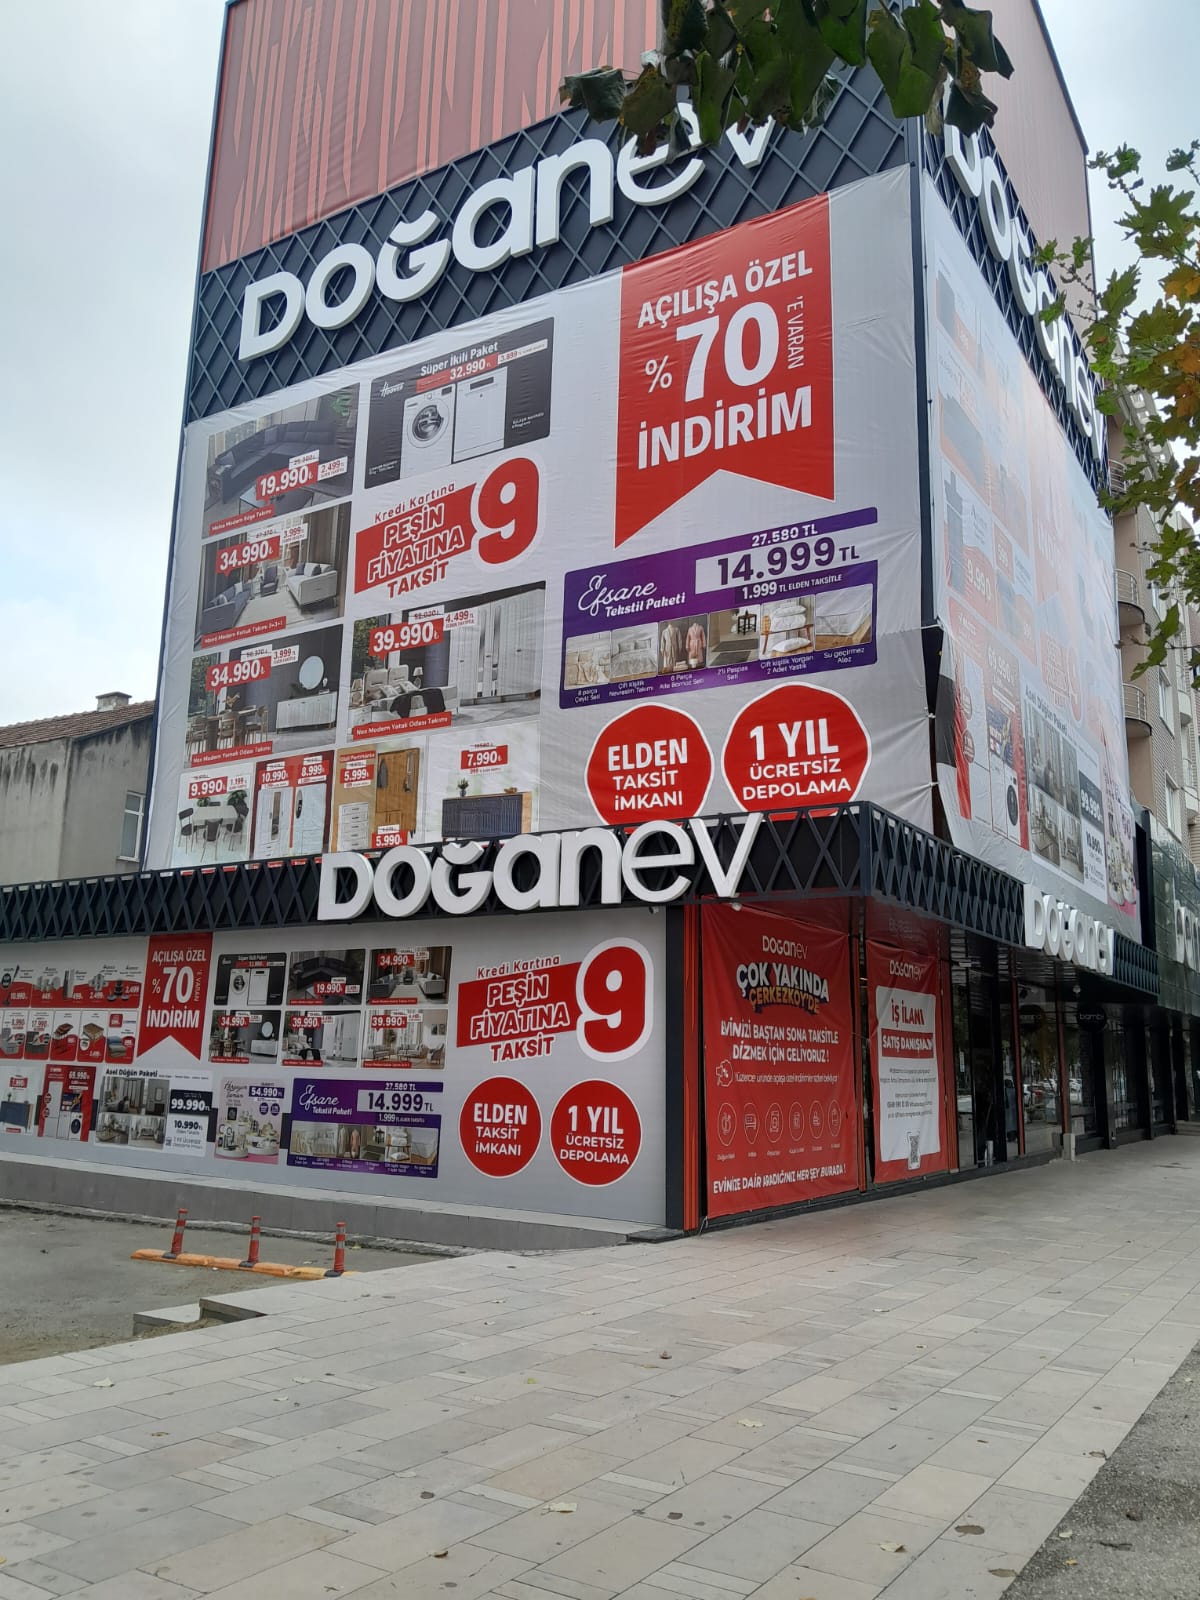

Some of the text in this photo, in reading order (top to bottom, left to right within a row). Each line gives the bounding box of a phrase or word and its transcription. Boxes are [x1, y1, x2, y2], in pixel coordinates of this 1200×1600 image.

[637, 250, 812, 328] AÇILIŞA ÖZEL
[420, 358, 448, 377] Süper
[450, 352, 468, 368] İkili
[470, 342, 498, 359] Paket
[645, 355, 673, 393] %
[676, 302, 779, 402] 70
[638, 385, 812, 470] İNDİRİM
[375, 483, 455, 523] Kredi Kartına
[384, 457, 540, 564] PEŞİN 9
[752, 524, 818, 547] 27.580 TL
[368, 526, 464, 583] FİYATINA
[718, 536, 860, 585] 14.999 TL
[387, 559, 449, 598] TAKSİT
[742, 582, 777, 600] 1.999
[788, 580, 810, 590] ELDEN
[811, 573, 842, 587] TAKSİTLE
[578, 574, 657, 617] Efsane
[605, 592, 686, 618] Tekstil Paketi
[445, 610, 469, 624] 4.499
[750, 718, 838, 760] 1 YIL
[608, 737, 688, 771] ELDEN
[613, 767, 679, 791] TAKSİT
[750, 756, 841, 780] ÜCRETSİZ
[614, 790, 683, 811] İMKANI
[742, 778, 851, 800] DEPOLAMA
[152, 948, 207, 966] AÇILIŞA ÖZEL
[477, 955, 560, 979] Kredi Kartına
[162, 966, 194, 1004] 70
[736, 962, 830, 1002] ÇOK YAKINDA
[487, 946, 646, 1054] PEŞİN 9
[146, 1005, 200, 1028] İNDİRİM
[470, 1002, 571, 1040] FİYATINA
[891, 999, 925, 1028] İŞ İLANI
[753, 1024, 785, 1043] BAŞTAN
[786, 1026, 807, 1042] SONA
[808, 1026, 839, 1044] TAKSİTLE
[883, 1035, 900, 1053] SATIŞ
[490, 1035, 555, 1062] TAKSİT
[732, 1040, 767, 1060] DİZMEK
[768, 1043, 785, 1065] İÇİN
[368, 1092, 434, 1112] 14.999 TL
[473, 1103, 528, 1125] ELDEN
[476, 1125, 519, 1140] TAKSİT
[568, 1105, 624, 1134] 1 YIL
[475, 1141, 521, 1156] İMKANI
[565, 1132, 624, 1149] ÜCRETSİZ
[560, 1149, 629, 1165] DEPOLAMA
[713, 1175, 741, 1194] EVİNİZE
[742, 1173, 762, 1190] DAİR
